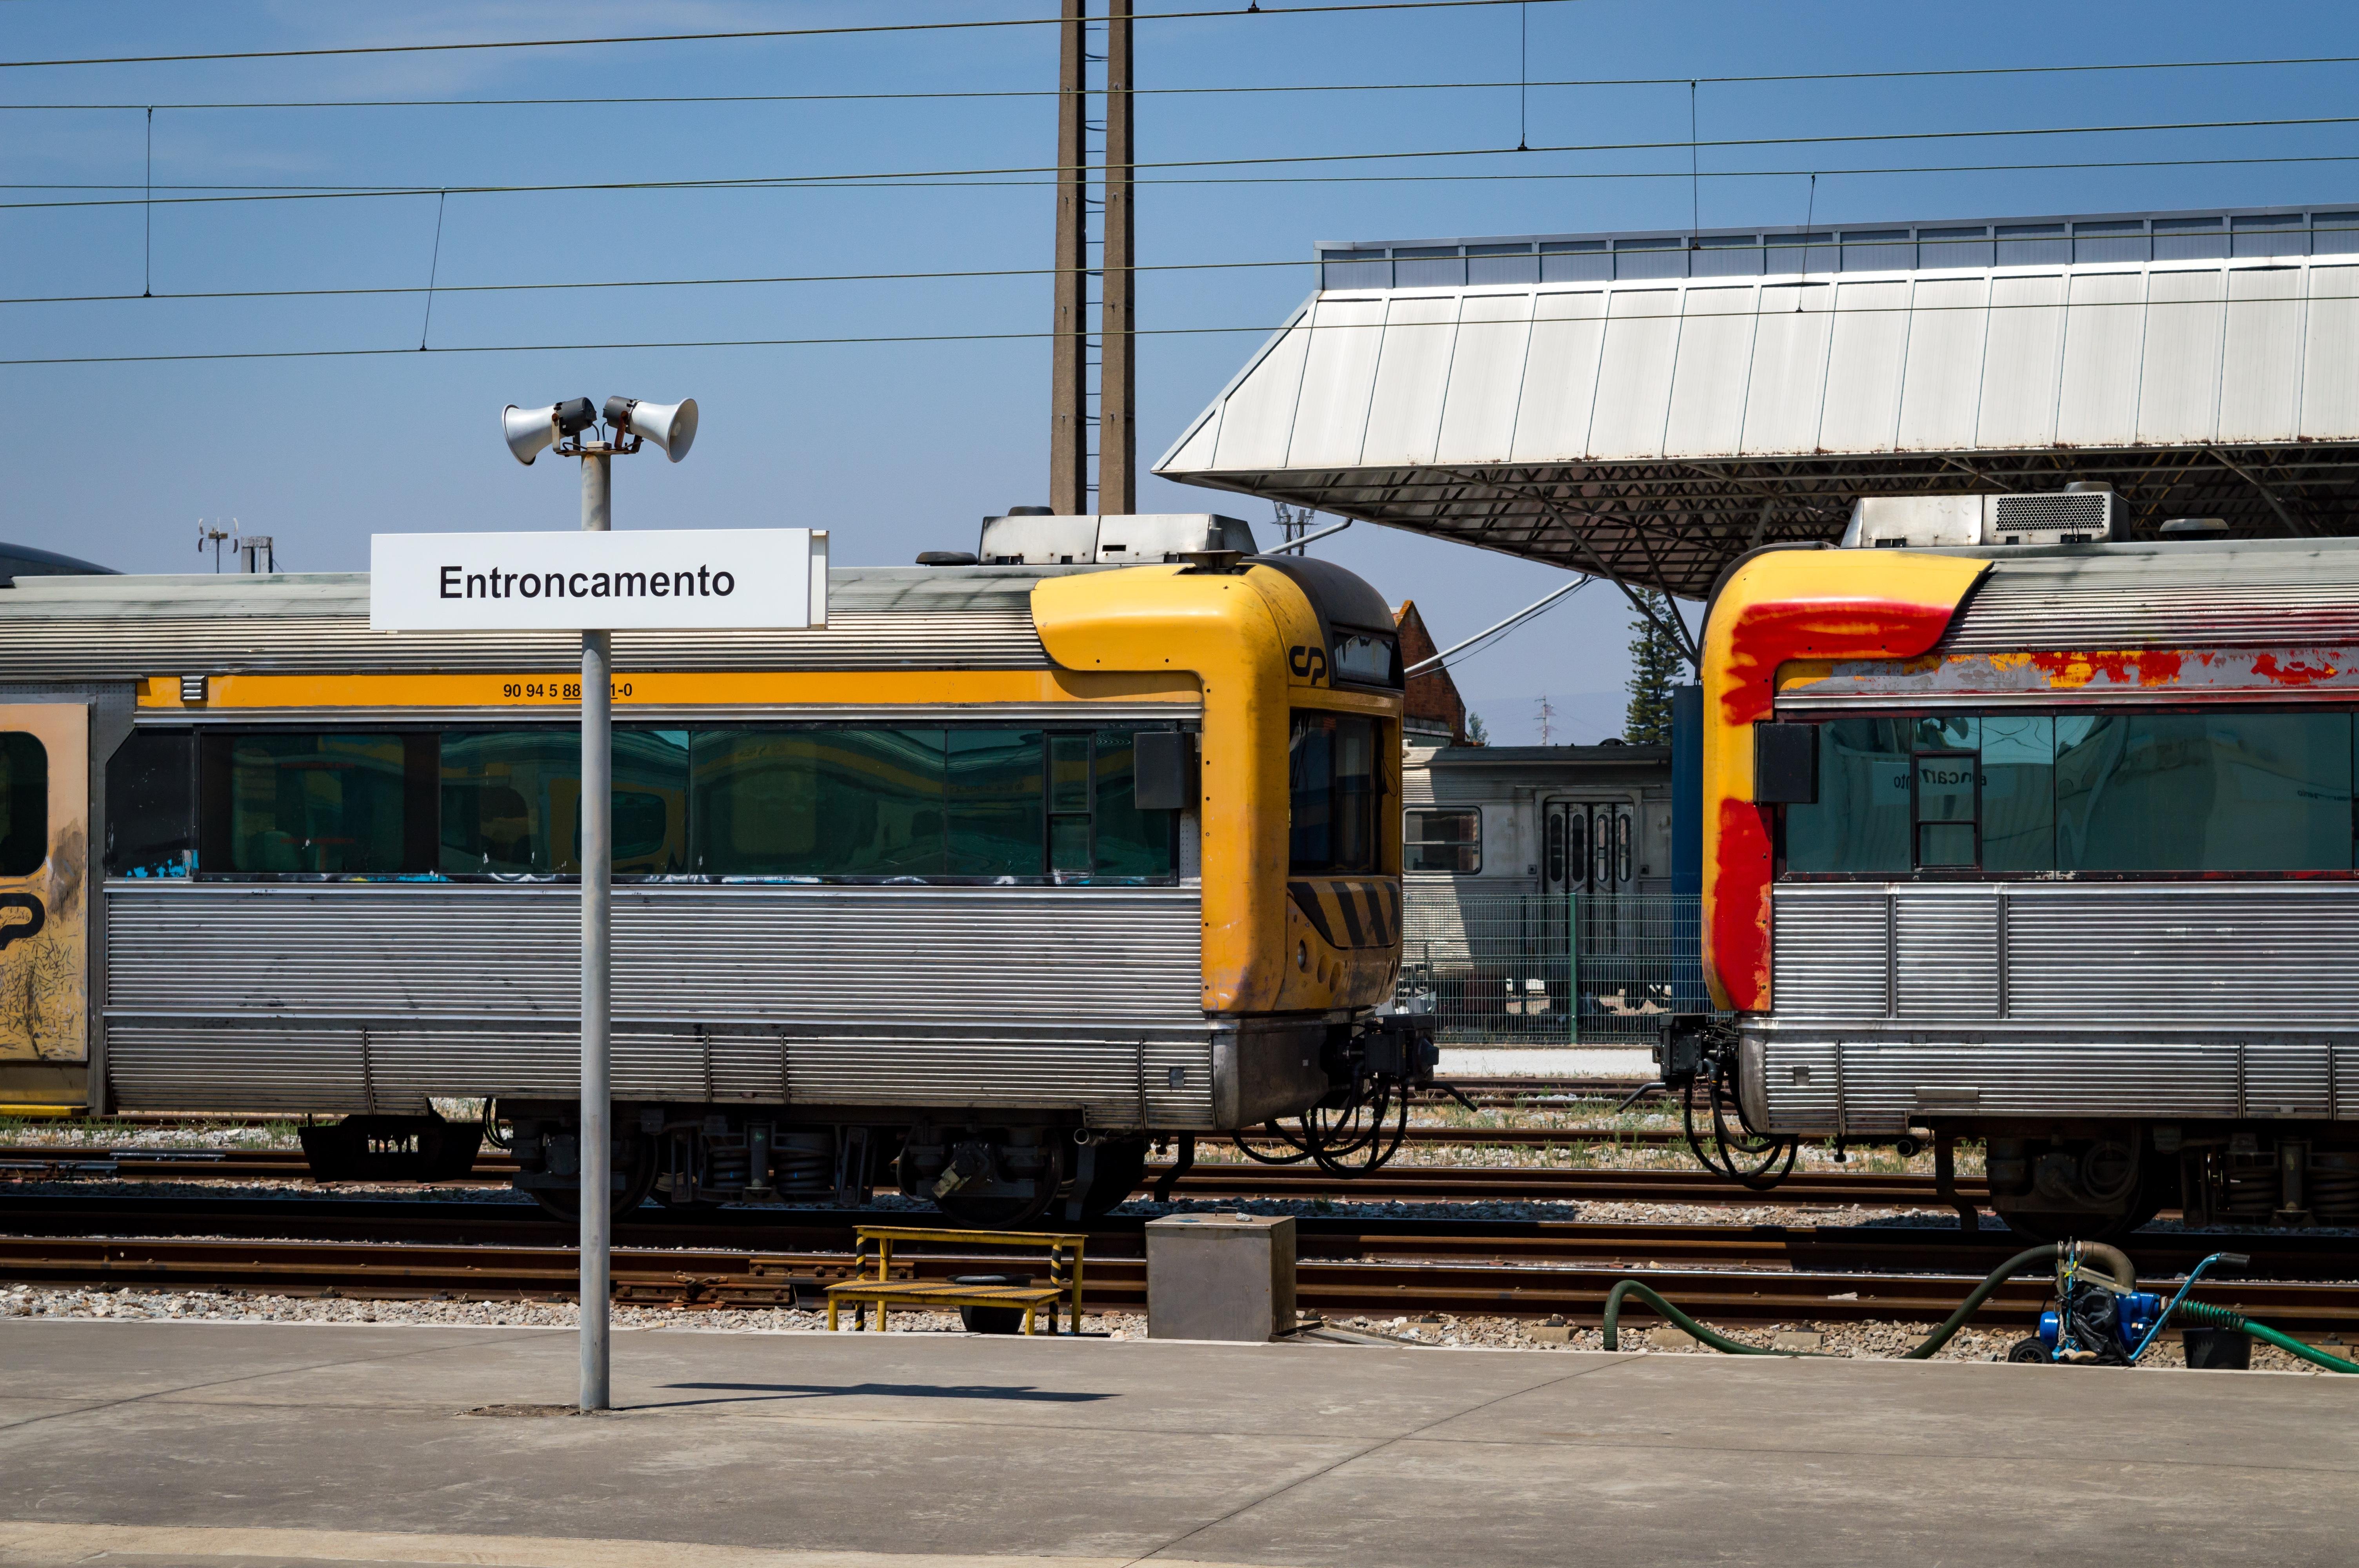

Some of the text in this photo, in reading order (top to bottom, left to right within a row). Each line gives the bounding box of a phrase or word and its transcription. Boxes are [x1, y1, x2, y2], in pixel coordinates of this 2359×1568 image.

[441, 564, 734, 598] Entroncamento
[1289, 645, 1327, 686] CP
[504, 684, 521, 697] 90
[527, 684, 543, 697] 94
[550, 684, 557, 697] 5
